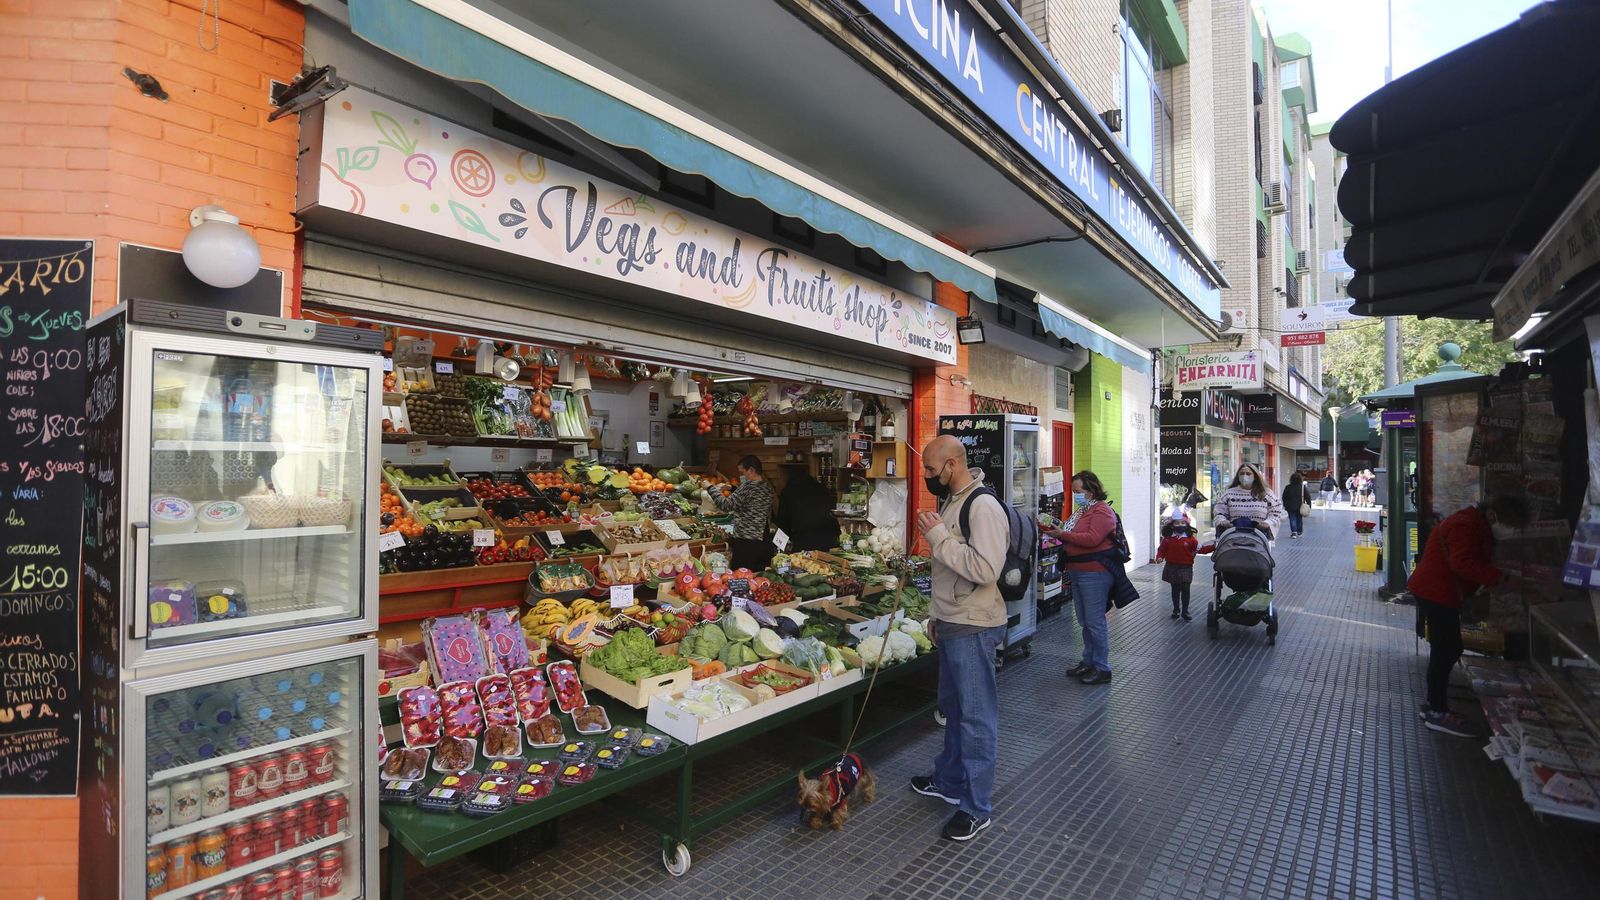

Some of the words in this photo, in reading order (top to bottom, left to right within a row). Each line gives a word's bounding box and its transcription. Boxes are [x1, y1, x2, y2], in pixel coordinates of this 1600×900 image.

[1016, 82, 1099, 201] CENTRAL
[1109, 177, 1171, 270] TEJERINGOS
[537, 181, 663, 276] Vegs
[675, 237, 744, 289] and
[756, 247, 837, 316] Fruits
[844, 284, 889, 344] shop
[907, 333, 932, 350] SINCE
[934, 341, 952, 355] 2007
[11, 346, 29, 365] LAS
[33, 348, 81, 380] 9:00
[1178, 364, 1258, 385] ENCARNITA
[8, 407, 39, 421] SOBRE
[1205, 389, 1245, 427] MEGUSTA
[15, 422, 36, 434] LAS
[1160, 447, 1182, 455] Moda
[1183, 446, 1192, 455] al
[1165, 466, 1188, 475] mejor
[0, 563, 68, 592] 15:00
[8, 651, 76, 672] CERRADOS
[3, 669, 58, 688] ESTAMOS
